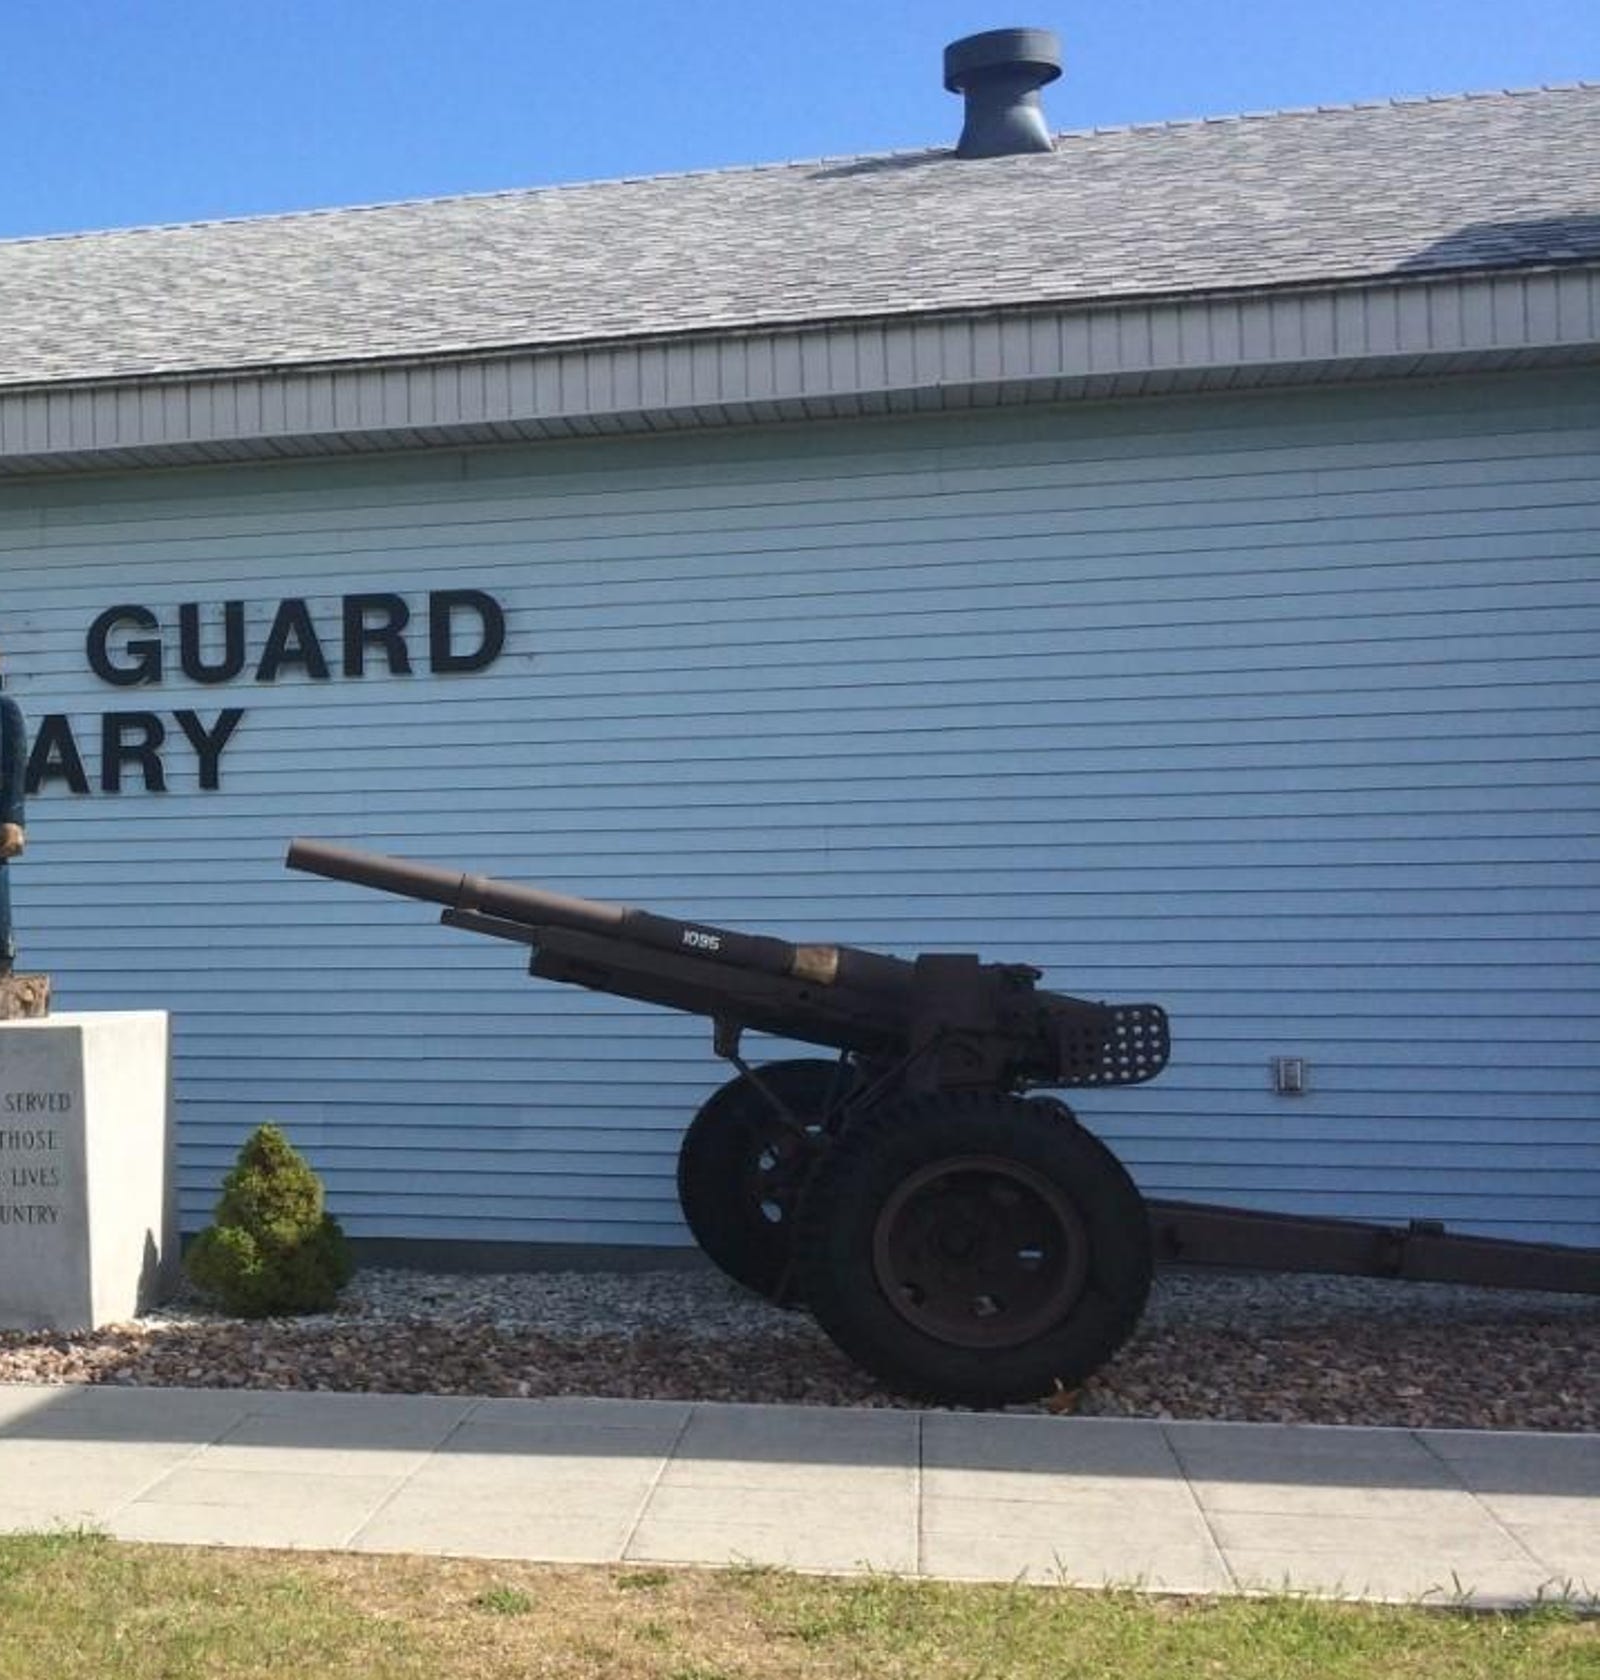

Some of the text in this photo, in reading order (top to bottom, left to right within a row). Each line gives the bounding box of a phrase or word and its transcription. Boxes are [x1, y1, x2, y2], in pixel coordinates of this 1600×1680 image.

[85, 589, 506, 687] GUARD
[681, 929, 721, 950] 1095
[4, 1092, 72, 1113] SERVED
[0, 1130, 57, 1150] THOSE
[12, 1167, 60, 1187] LIVES
